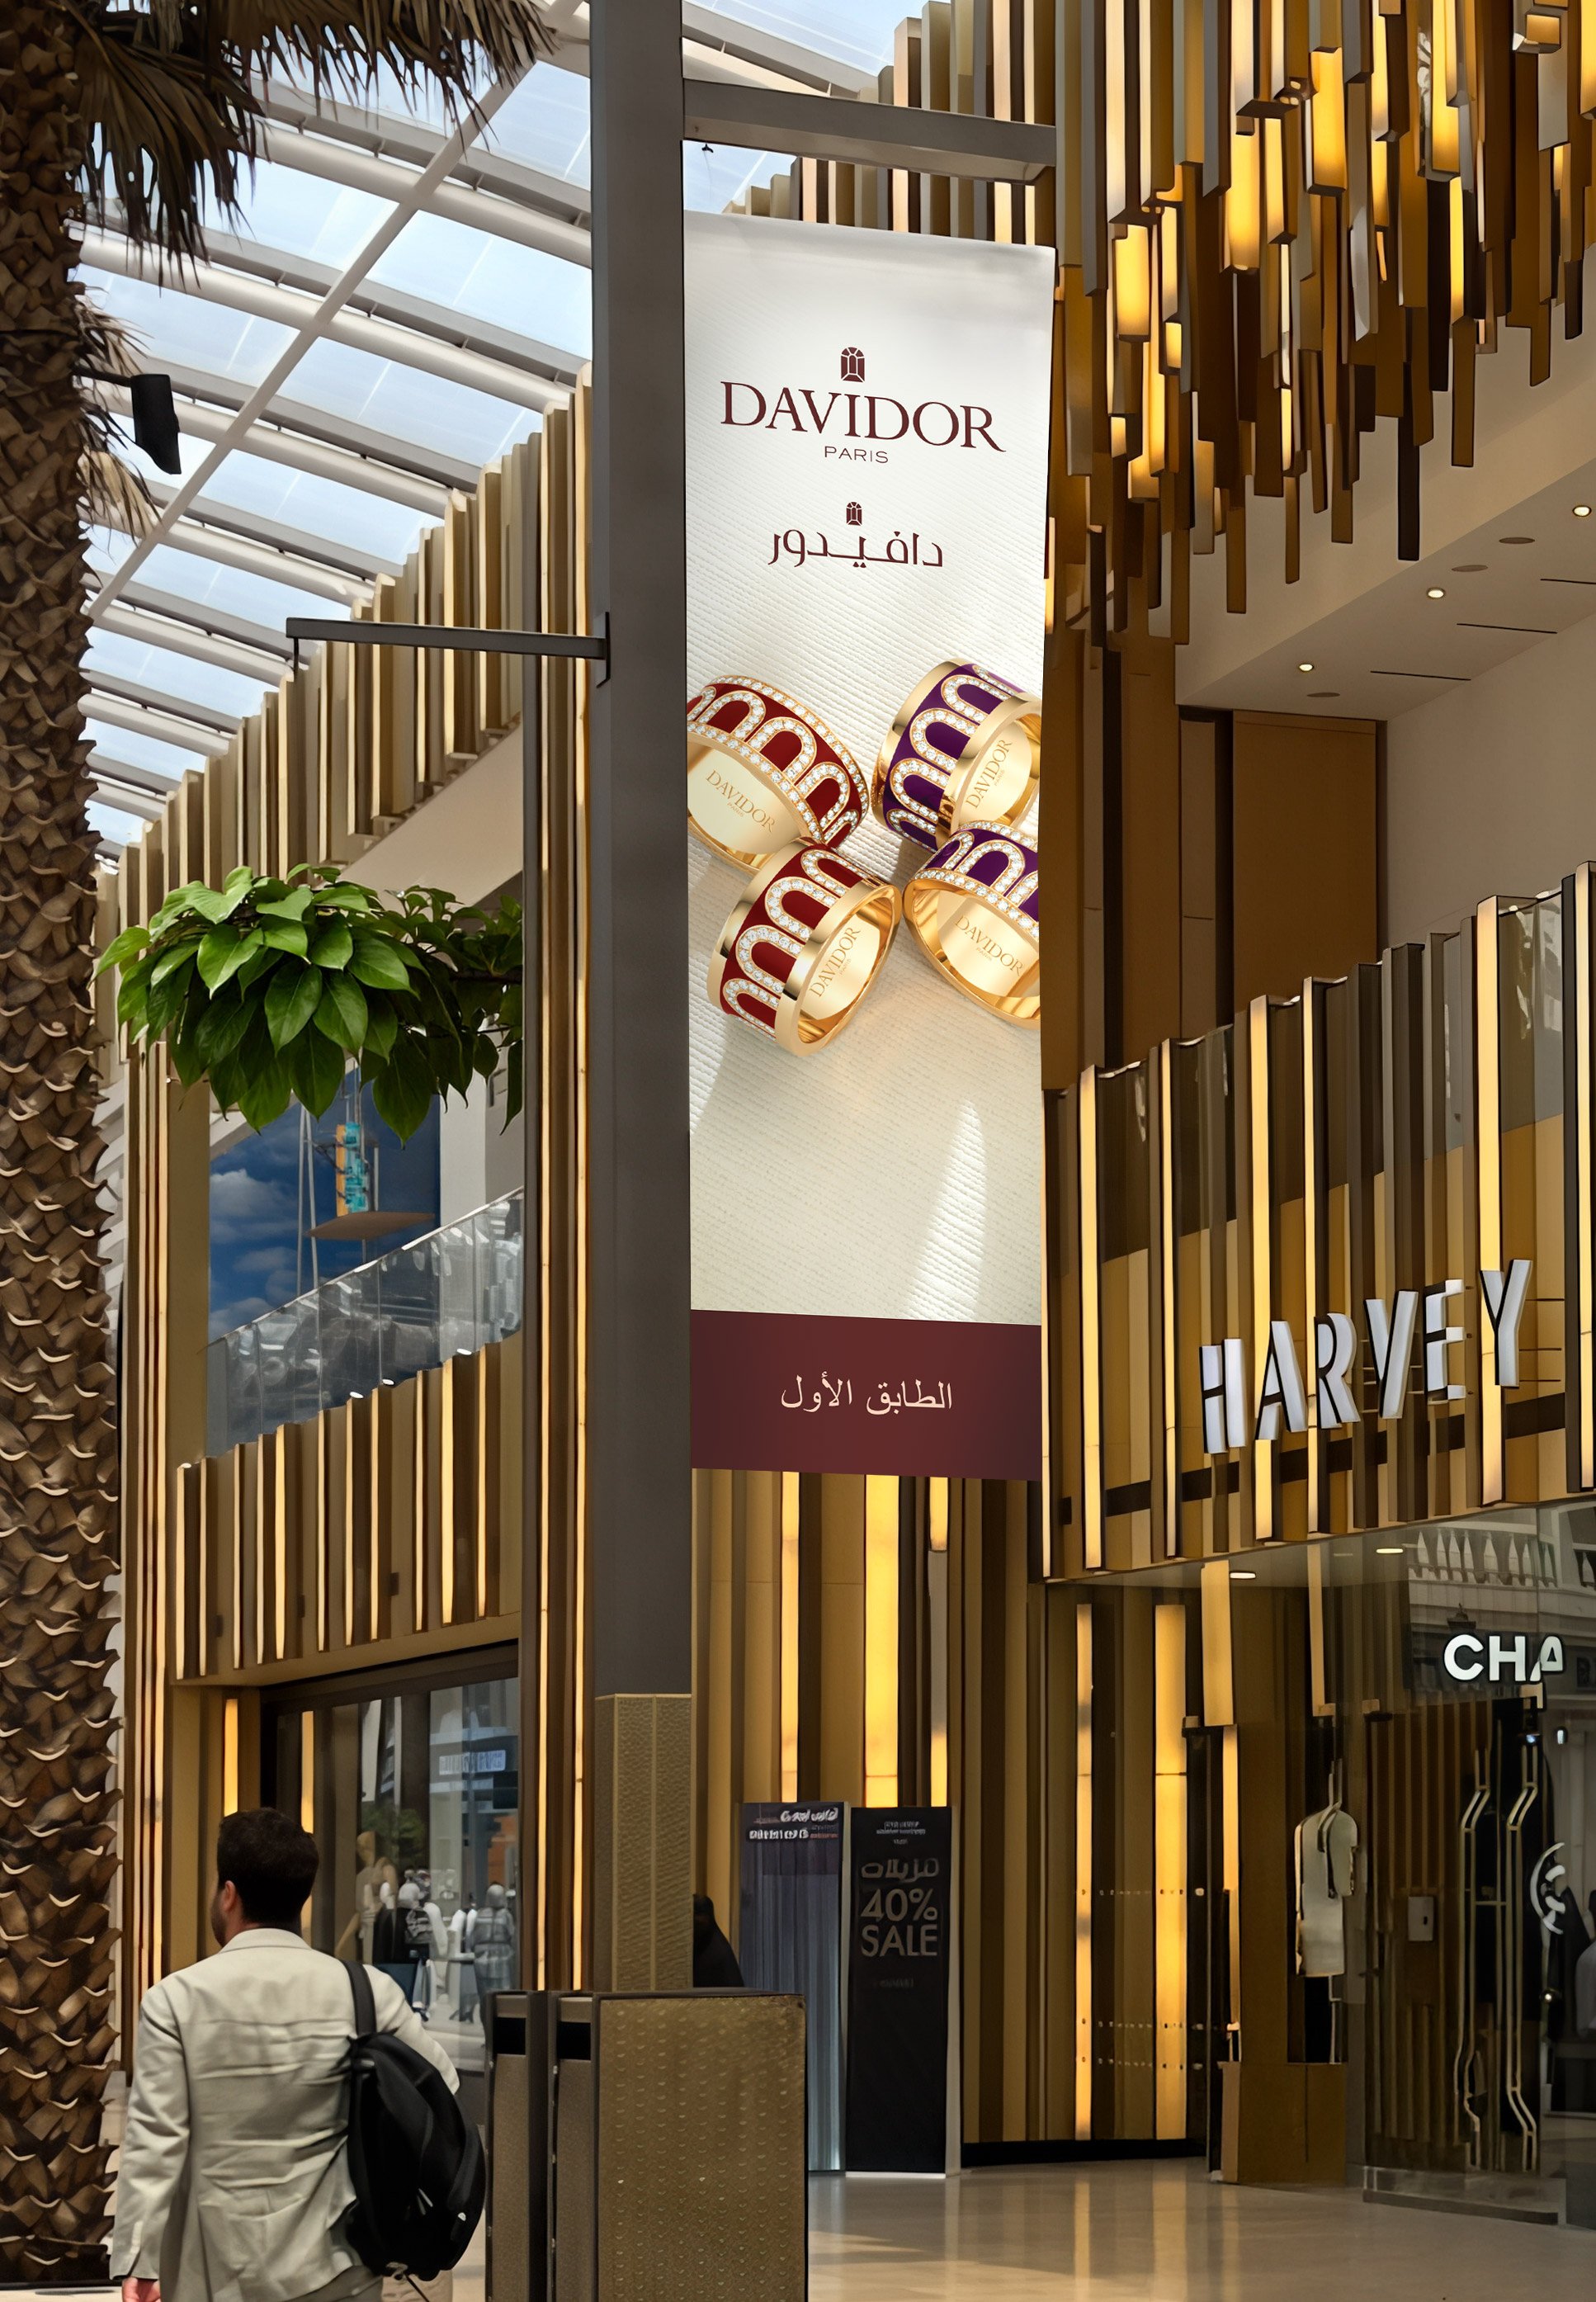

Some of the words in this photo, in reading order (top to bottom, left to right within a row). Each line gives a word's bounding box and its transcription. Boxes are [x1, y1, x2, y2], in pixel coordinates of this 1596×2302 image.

[720, 381, 1007, 452] DAVIDOR
[824, 446, 889, 464] PARIS
[767, 529, 943, 569] دافيدور
[966, 740, 1013, 808] DAVIDOR
[706, 770, 775, 833] DAVIDOR
[809, 927, 861, 997] DAVIDOR
[955, 915, 1023, 976] DAVIDOR
[1199, 1259, 1533, 1454] HARVEY
[781, 1371, 853, 1413] الأول
[866, 1378, 953, 1416] الطابق
[860, 1888, 938, 1922] 40%
[861, 1924, 938, 1958] SALE
